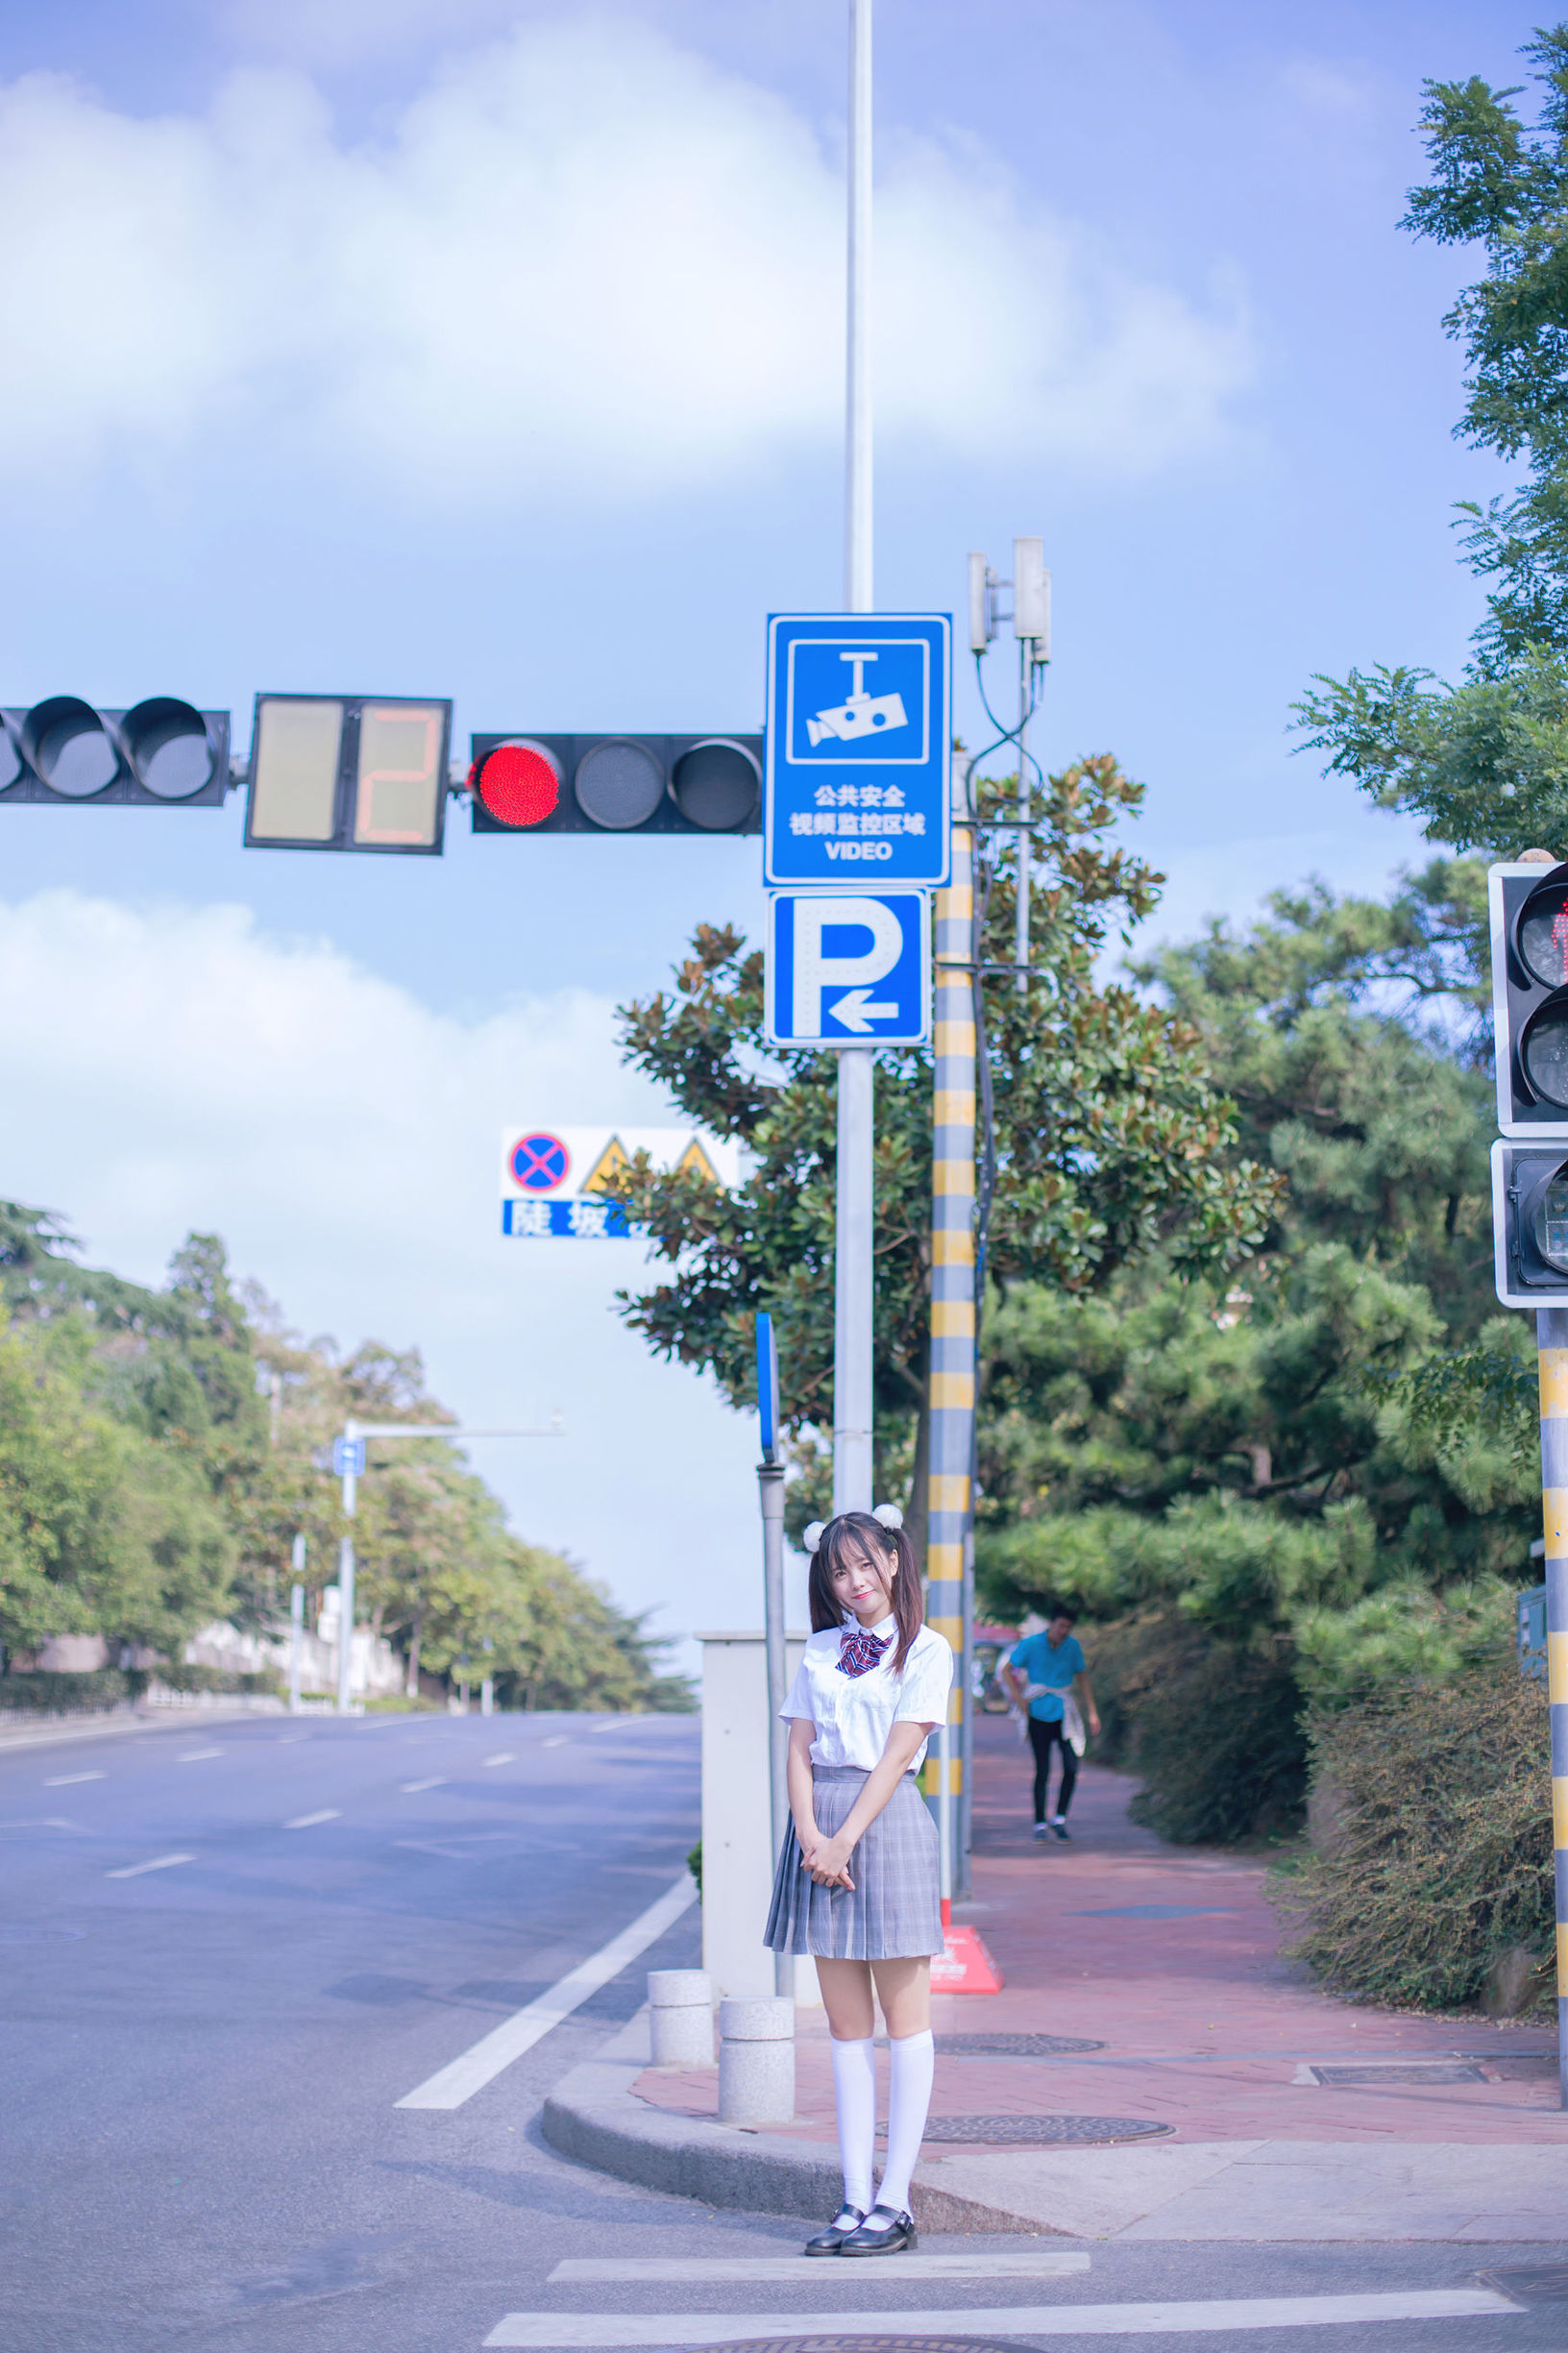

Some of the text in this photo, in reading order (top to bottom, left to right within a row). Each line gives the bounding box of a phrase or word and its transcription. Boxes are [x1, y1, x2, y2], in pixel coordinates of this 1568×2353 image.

[358, 709, 438, 842] 2
[814, 784, 906, 808] 公共安全
[789, 812, 926, 837] 视频监控区域
[824, 841, 894, 861] VIDEO
[792, 897, 903, 1038] P
